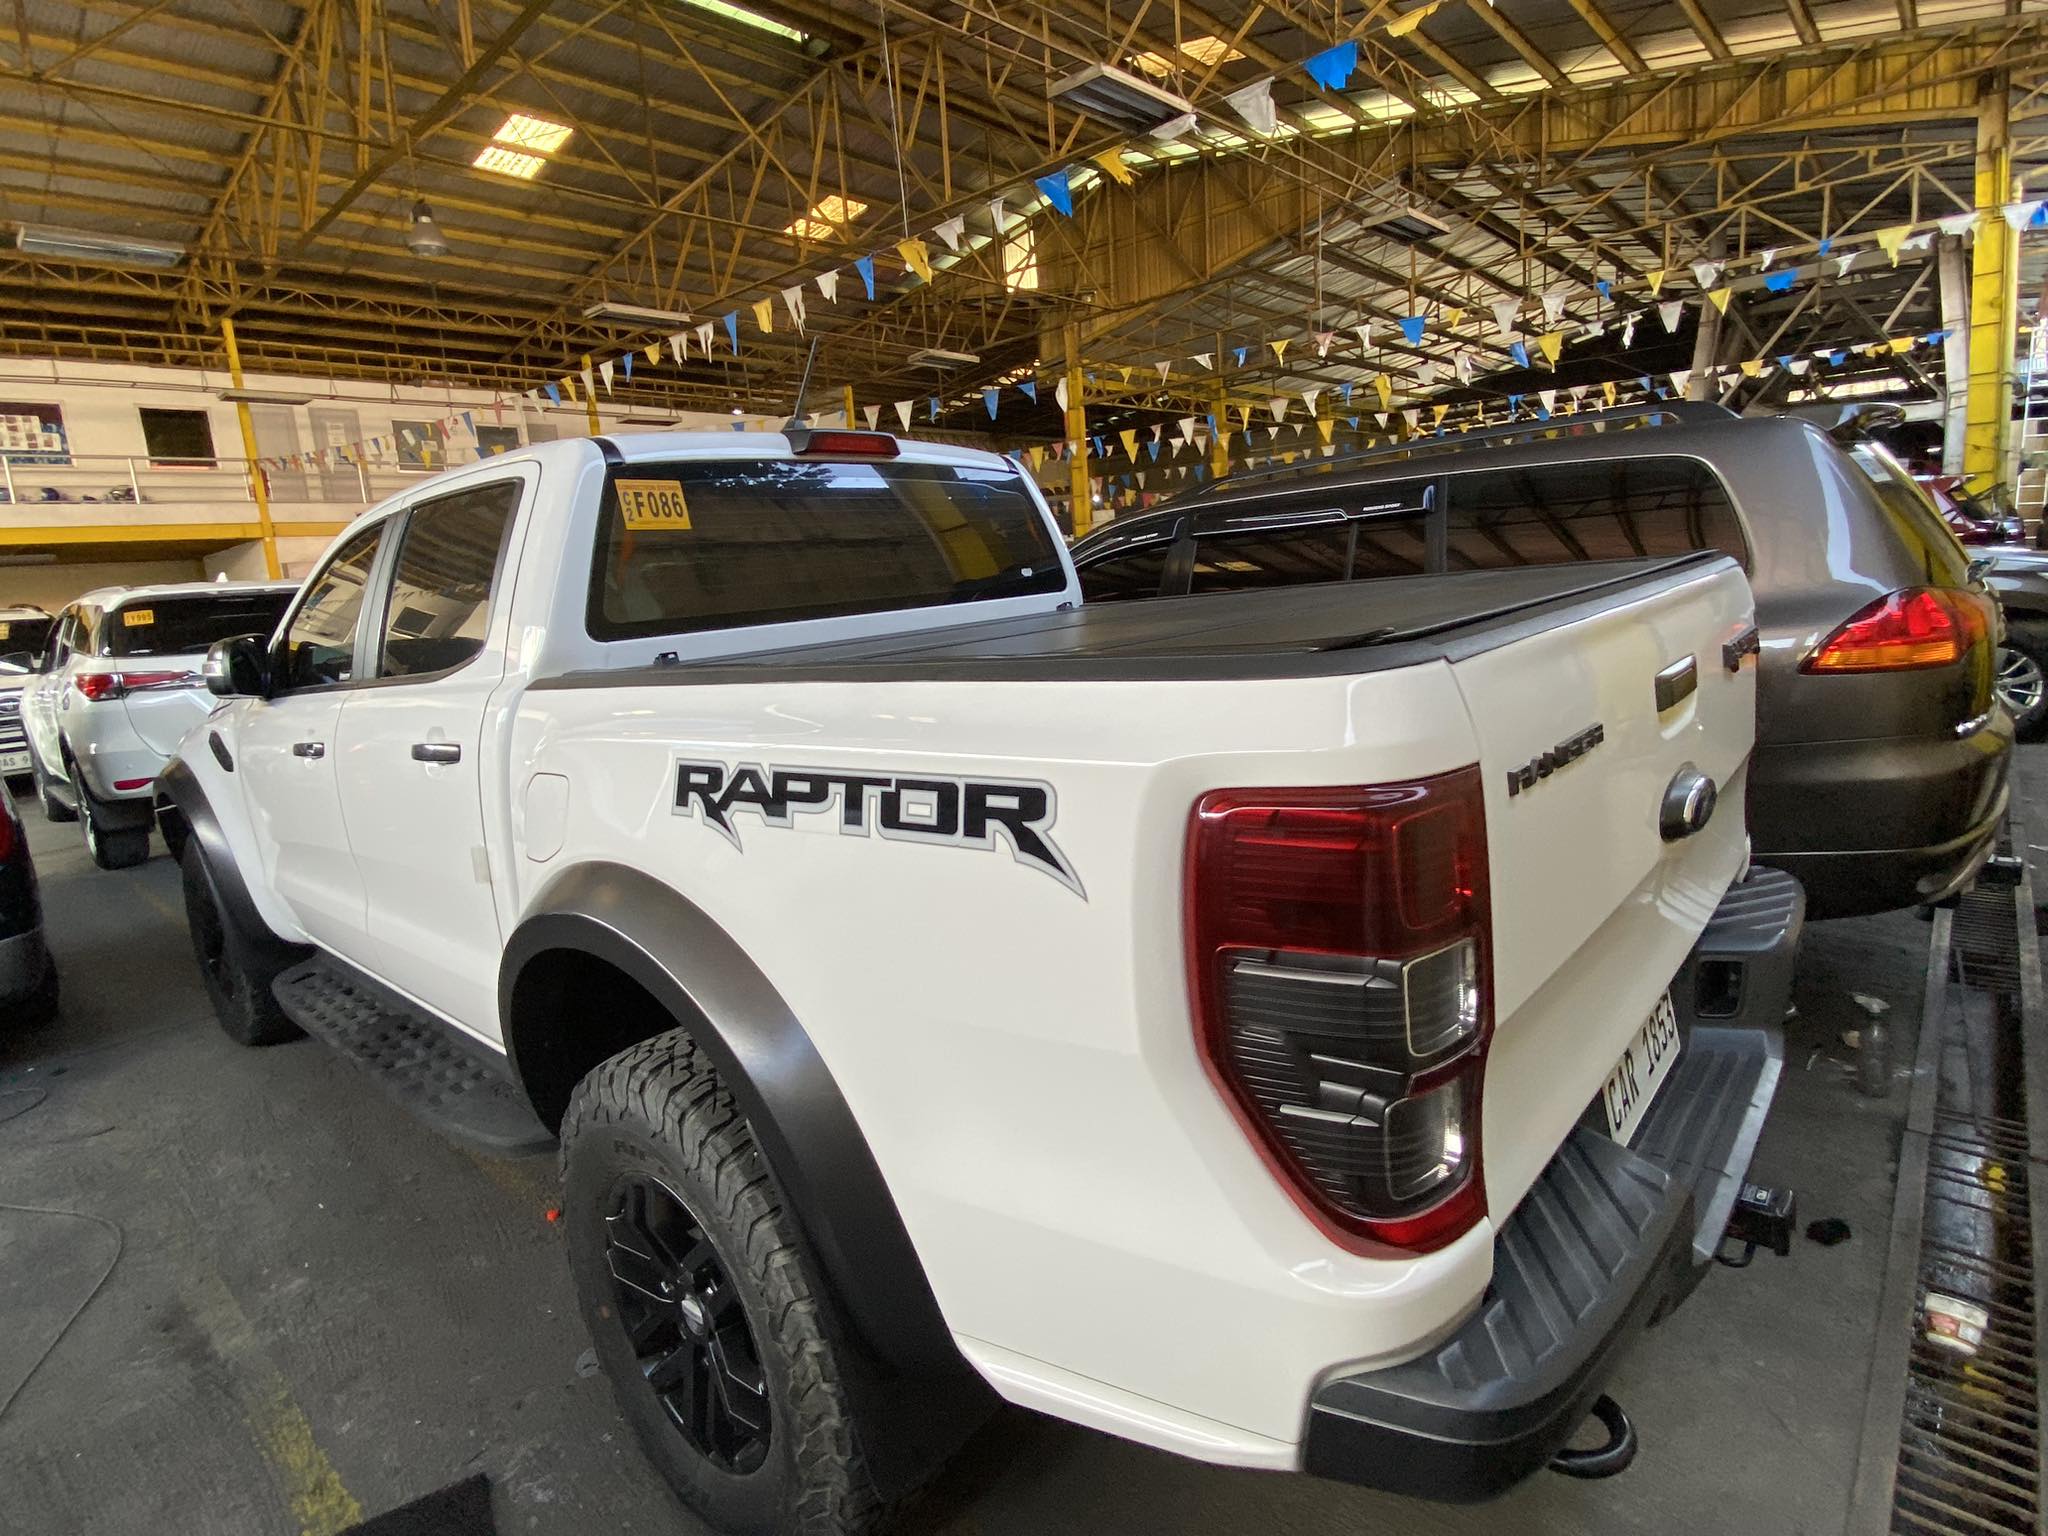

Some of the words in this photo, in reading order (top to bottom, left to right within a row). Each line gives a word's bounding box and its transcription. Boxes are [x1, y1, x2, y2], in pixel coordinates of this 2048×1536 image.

[633, 491, 684, 518] F086
[672, 757, 1088, 902] RAPTOR
[1608, 1048, 1640, 1131] CAR
[1642, 993, 1675, 1077] 1853
